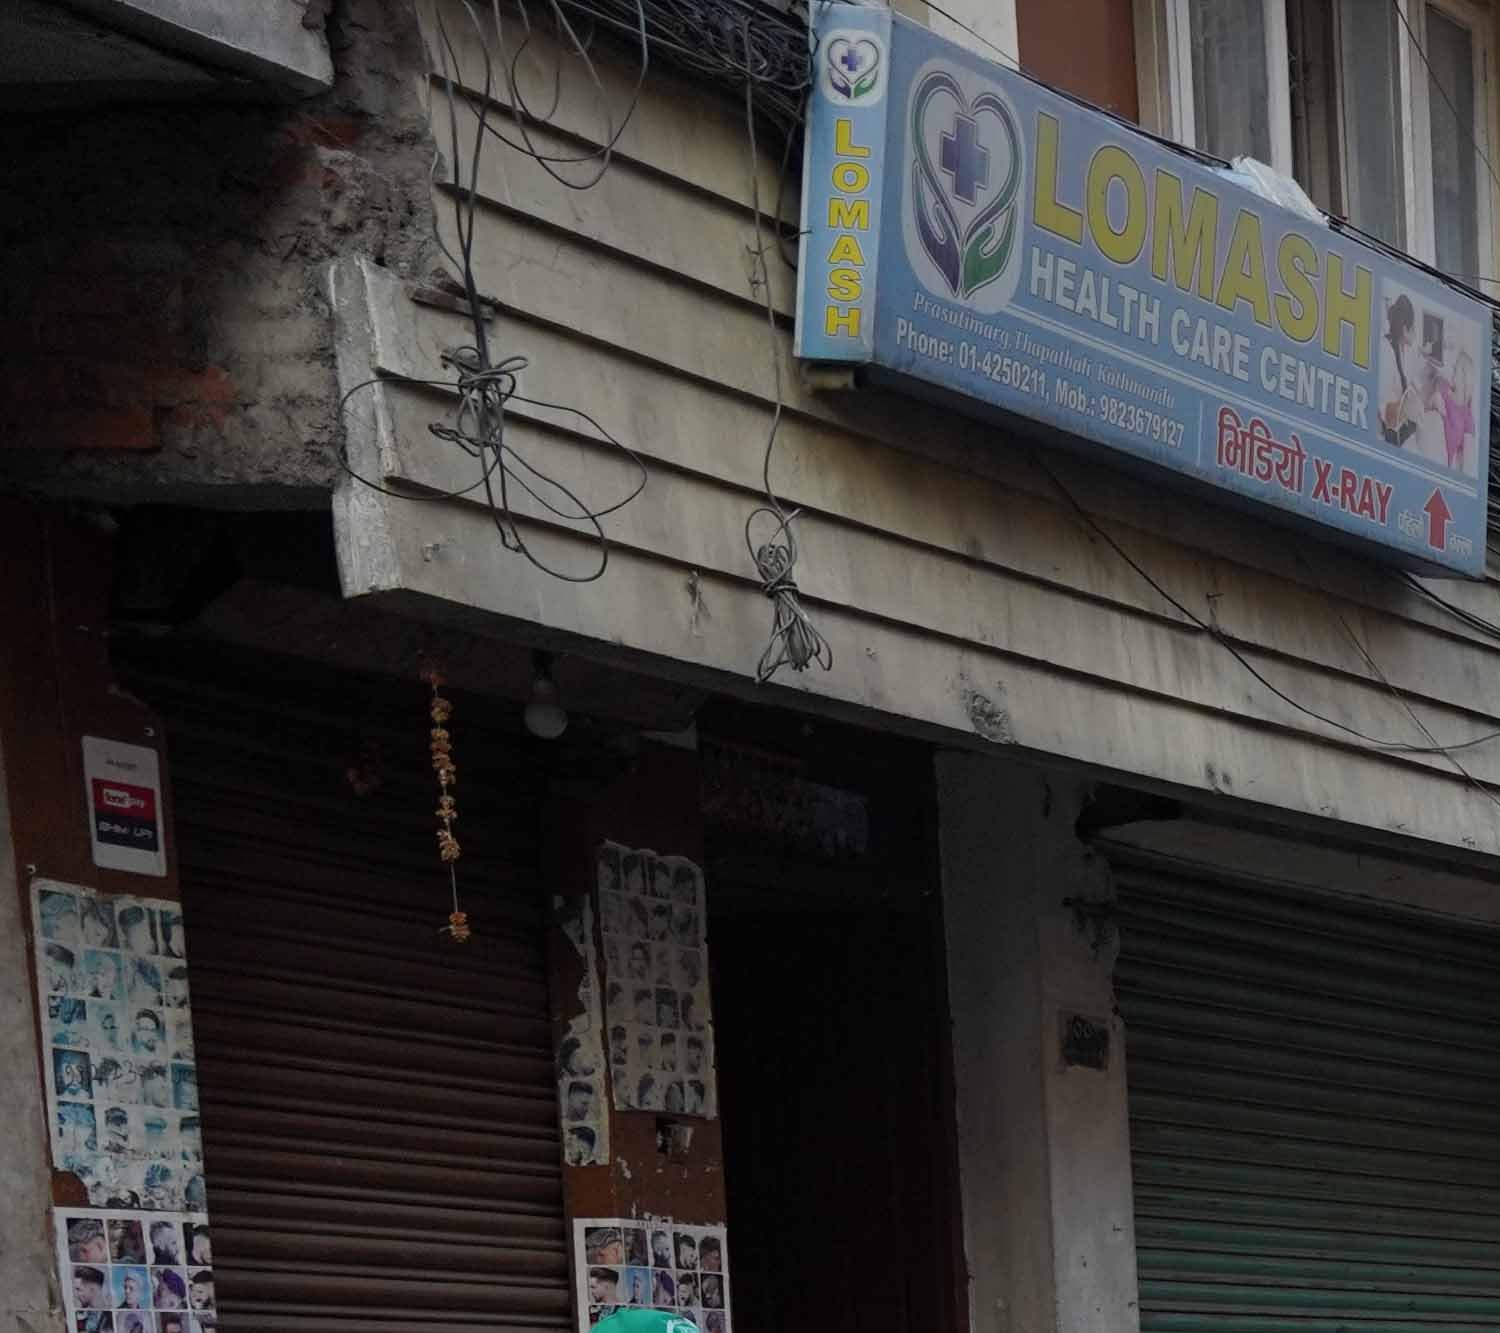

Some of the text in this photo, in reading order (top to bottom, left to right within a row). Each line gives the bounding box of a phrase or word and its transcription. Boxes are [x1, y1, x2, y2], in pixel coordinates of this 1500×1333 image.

[826, 119, 871, 337] LOMASH
[1033, 112, 1373, 370] LOMASH
[896, 318, 953, 365] Phone:
[959, 341, 1050, 403] 01-4250211,
[1101, 395, 1185, 449] 9823679127
[1030, 247, 1369, 430] HEALTH CARE CENTER
[1217, 404, 1307, 495] भिडियो
[1312, 456, 1393, 526] X-RAY
